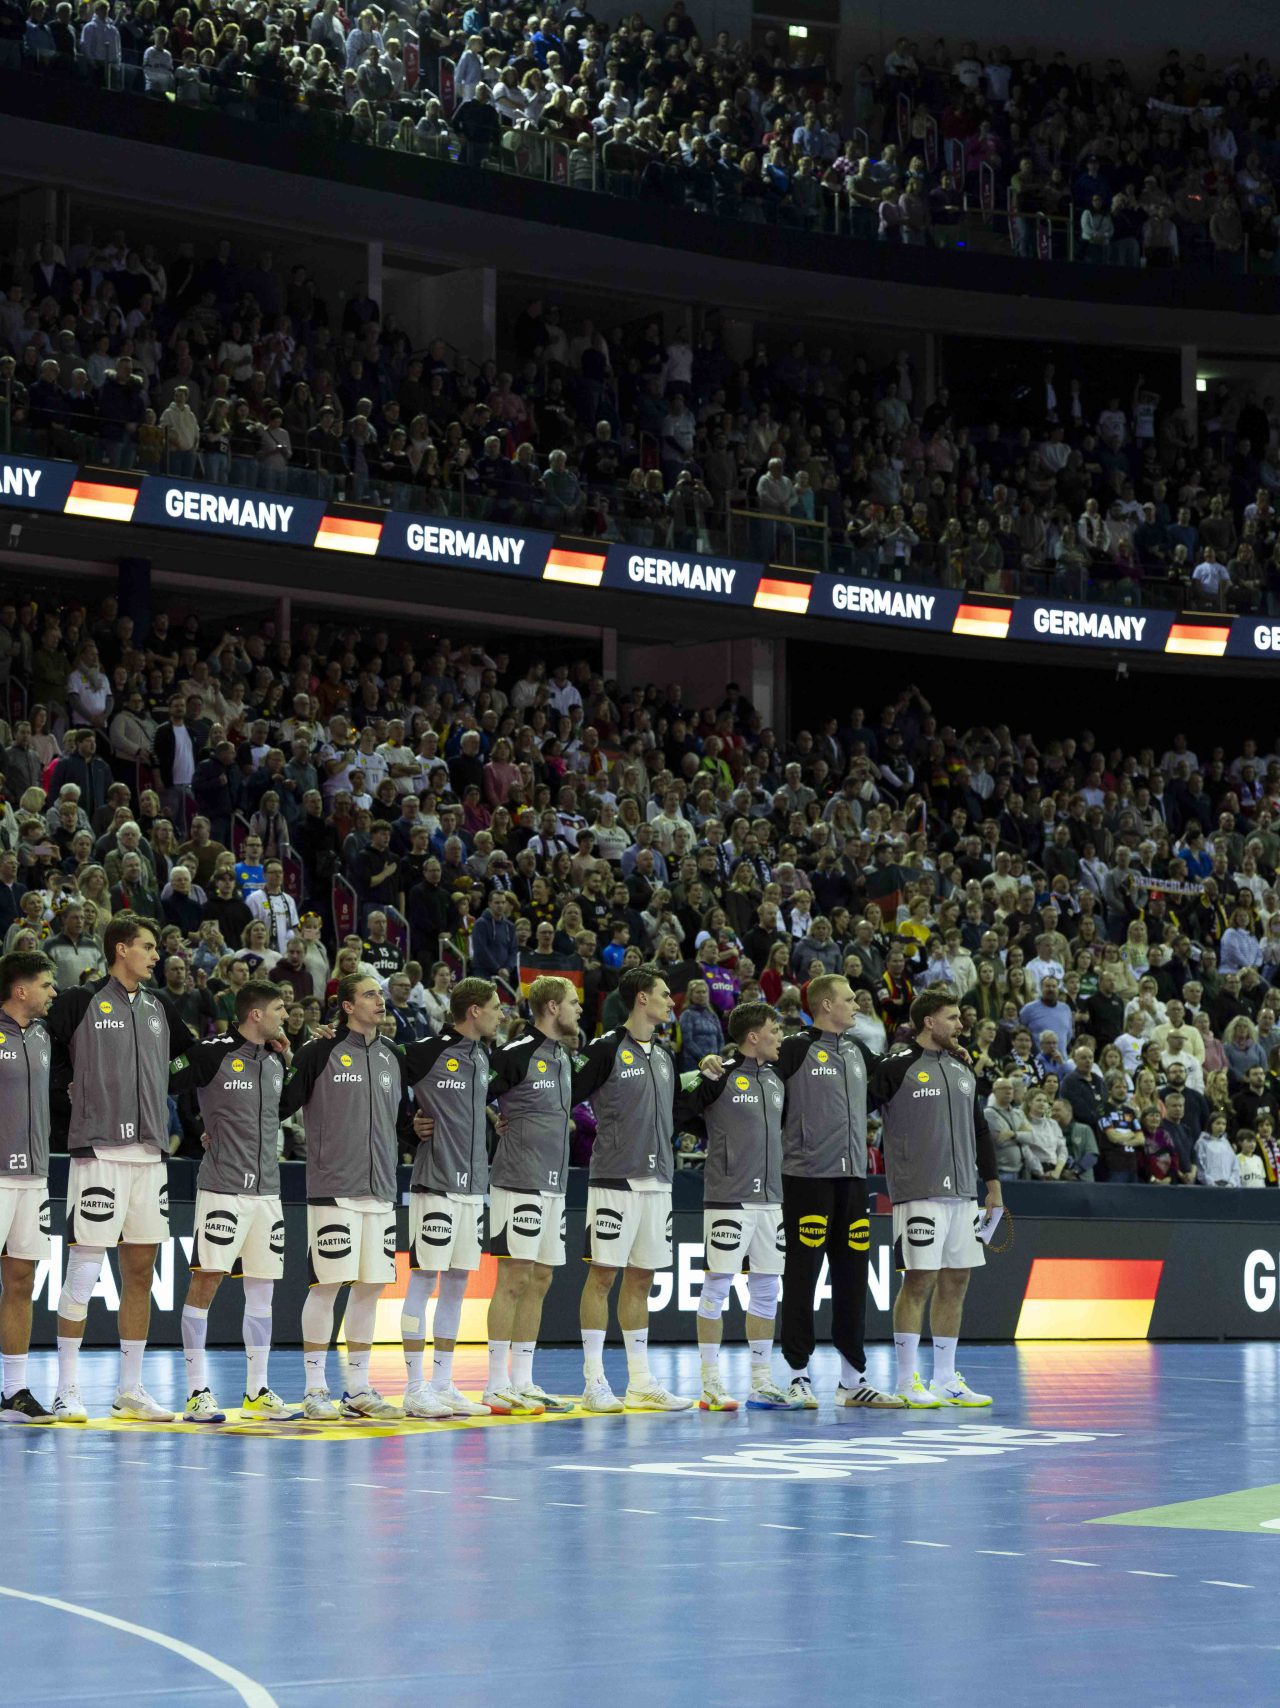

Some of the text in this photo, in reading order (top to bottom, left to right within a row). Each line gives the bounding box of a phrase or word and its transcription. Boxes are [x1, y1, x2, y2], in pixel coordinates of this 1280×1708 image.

[166, 491, 293, 532] GERMANY
[407, 524, 525, 562] GERMANY
[629, 555, 736, 594] GERMANY
[833, 583, 935, 620] GERMANY
[1034, 608, 1147, 641] GERMANY
[341, 903, 348, 914] 8
[378, 946, 390, 957] 15
[95, 1019, 124, 1029] atlas
[621, 1067, 645, 1078] atlas
[812, 1067, 837, 1075] atlas
[334, 1073, 362, 1082] atlas
[224, 1080, 253, 1089] atlas
[437, 1079, 466, 1089] atlas
[533, 1080, 555, 1089] atlas
[732, 1094, 758, 1103] atlas
[913, 1088, 940, 1098] atlas
[120, 1123, 134, 1139] 18
[10, 1154, 27, 1169] 23
[649, 1154, 656, 1168] 5
[244, 1173, 255, 1188] 17
[456, 1172, 467, 1187] 14
[549, 1171, 558, 1185] 13
[943, 1176, 951, 1189] 4
[753, 1179, 761, 1192] 3
[81, 1199, 114, 1209] HARTING
[513, 1216, 541, 1225] HARTING
[596, 1220, 622, 1231] ARTING
[205, 1222, 236, 1234] HARTING
[422, 1224, 452, 1234] HARTING
[799, 1225, 827, 1236] HARTING
[907, 1227, 935, 1237] HARTING
[711, 1231, 741, 1240] HARTING
[317, 1237, 351, 1246] HARTING
